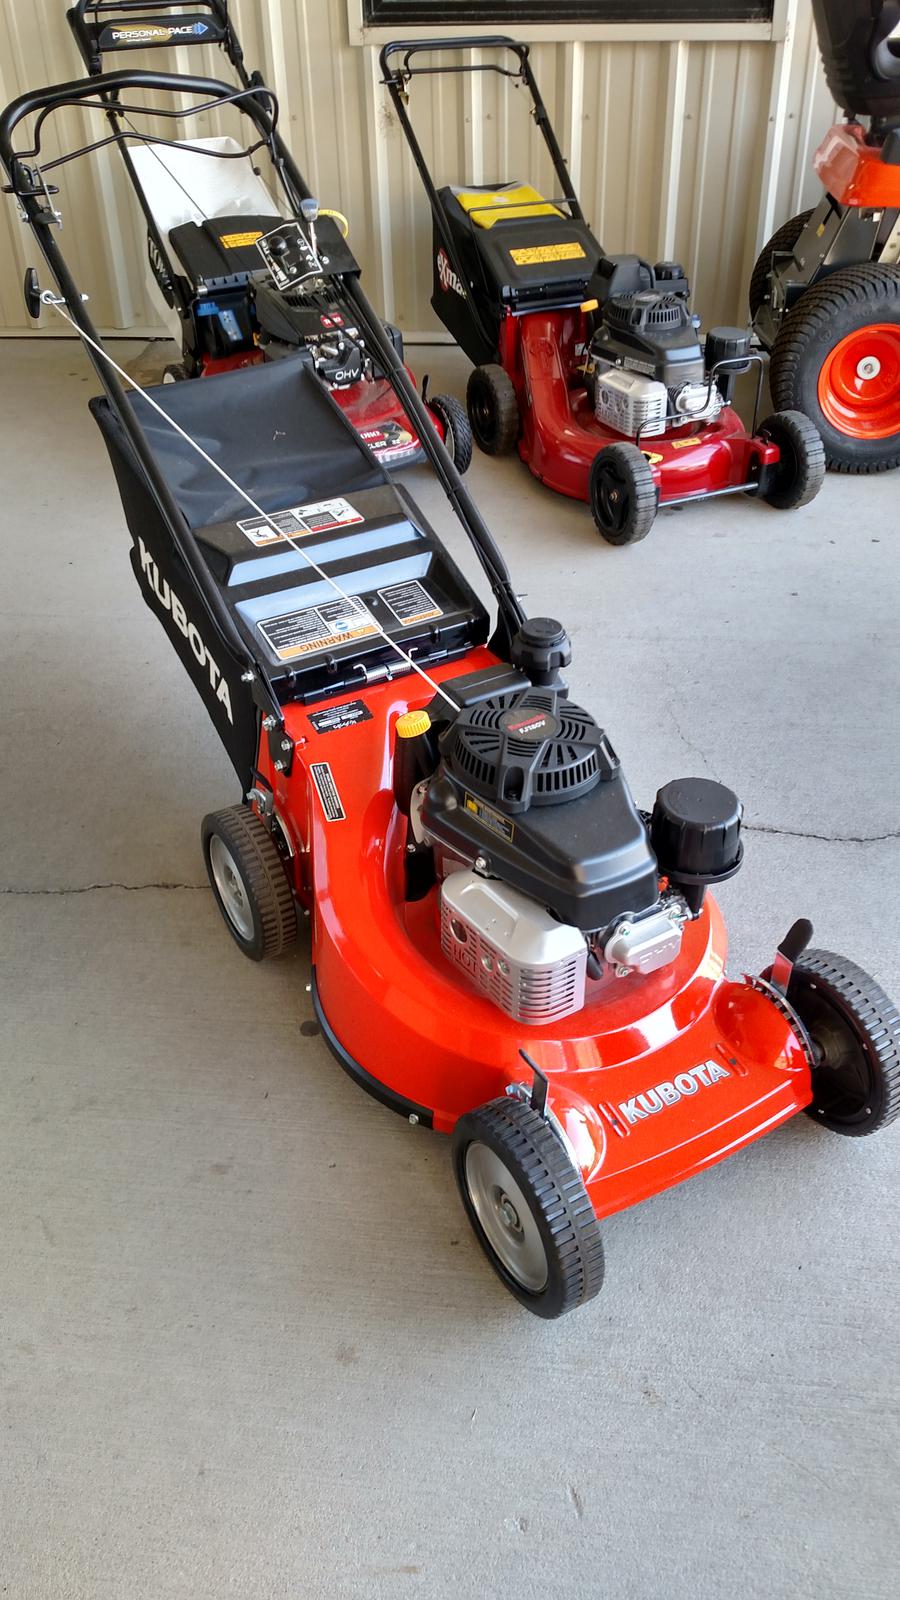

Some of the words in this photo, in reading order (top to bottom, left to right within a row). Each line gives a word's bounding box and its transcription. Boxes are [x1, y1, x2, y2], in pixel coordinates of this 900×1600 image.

[112, 29, 165, 40] PERSONAL
[167, 26, 193, 35] PACE
[335, 368, 359, 380] OHV
[137, 536, 233, 726] KUBOTA
[300, 632, 351, 652] WARNING
[453, 944, 477, 974] HOT
[618, 1059, 731, 1125] KUBOTA
